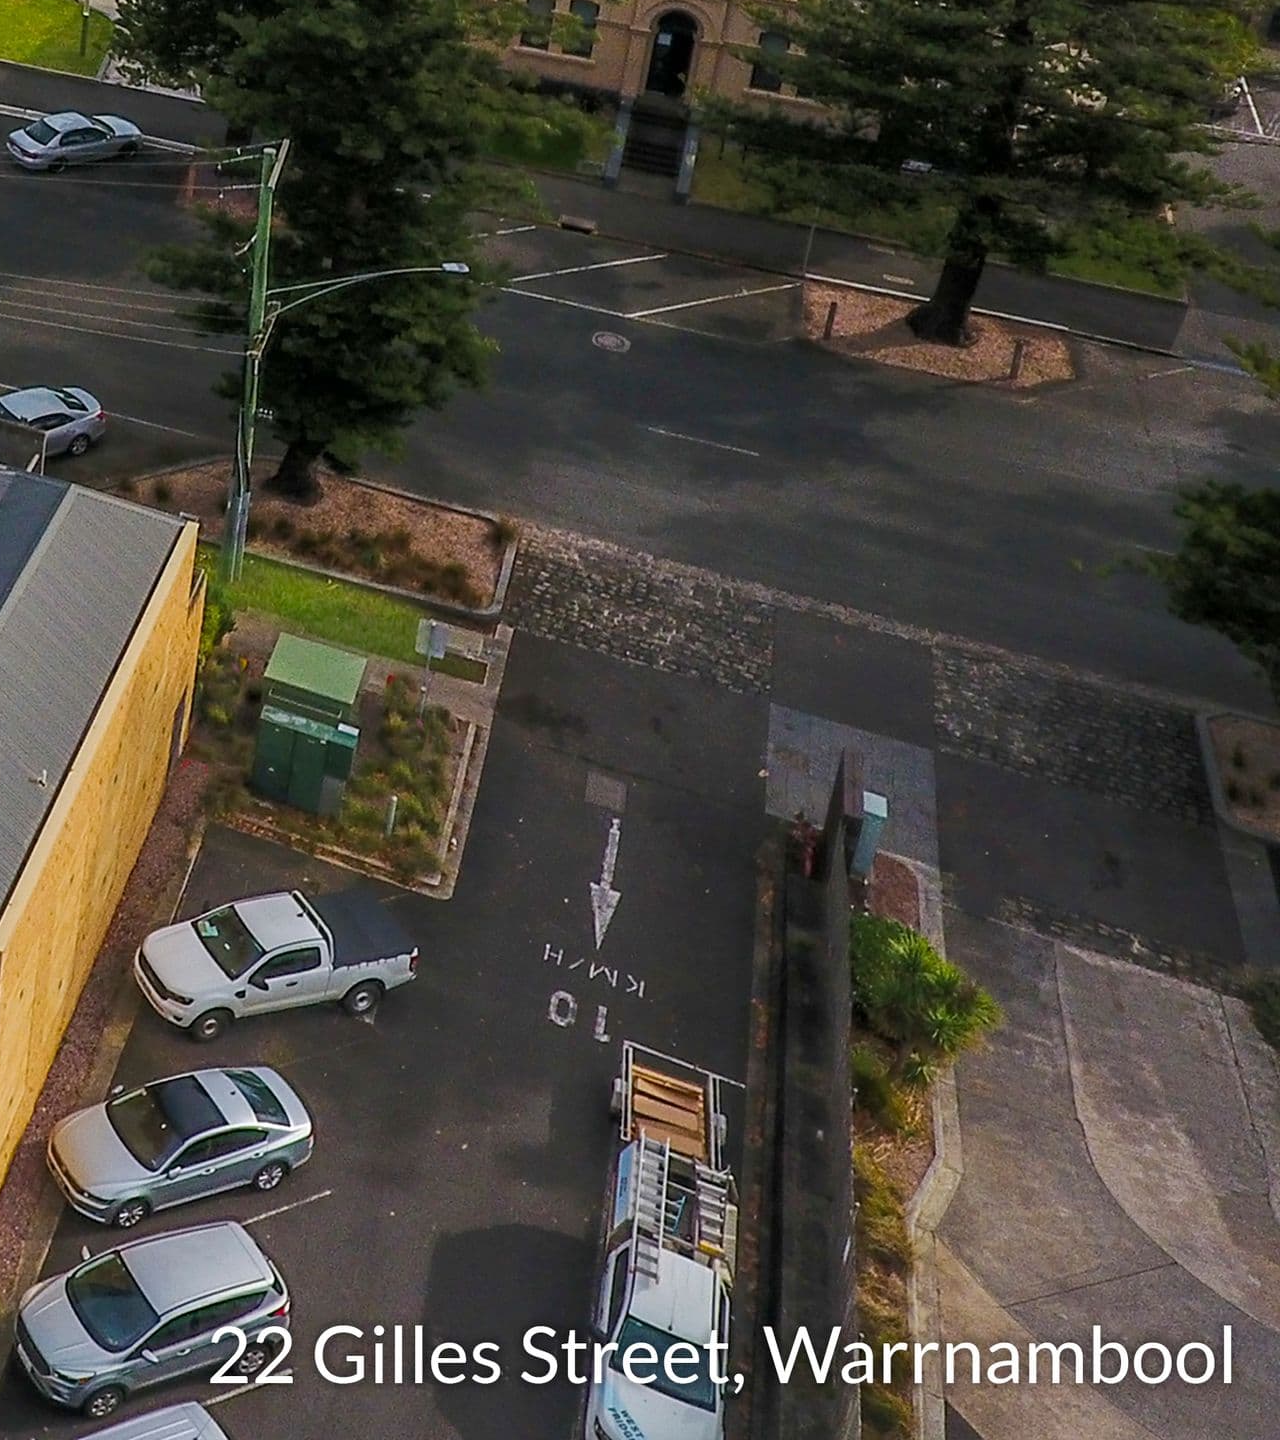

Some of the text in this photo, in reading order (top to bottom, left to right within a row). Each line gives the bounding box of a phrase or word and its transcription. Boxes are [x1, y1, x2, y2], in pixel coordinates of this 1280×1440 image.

[543, 943, 645, 999] KM/H
[548, 990, 610, 1043] 10
[621, 1410, 645, 1439] WEST
